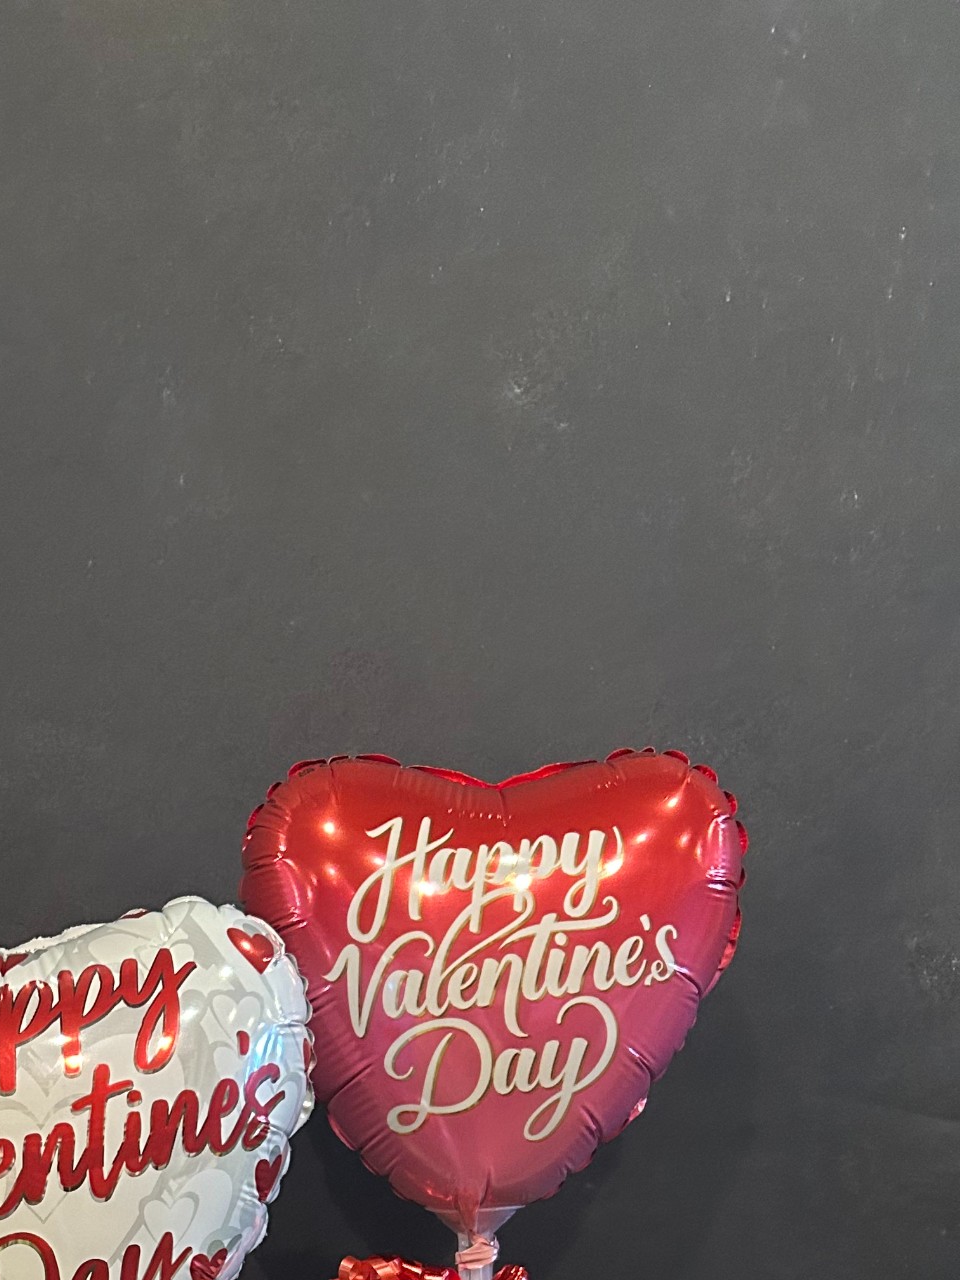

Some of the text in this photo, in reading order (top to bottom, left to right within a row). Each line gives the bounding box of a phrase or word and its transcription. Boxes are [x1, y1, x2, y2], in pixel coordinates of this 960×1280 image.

[346, 816, 624, 943] Happy
[322, 890, 679, 1038] Valentine's
[383, 995, 618, 1141] Day
